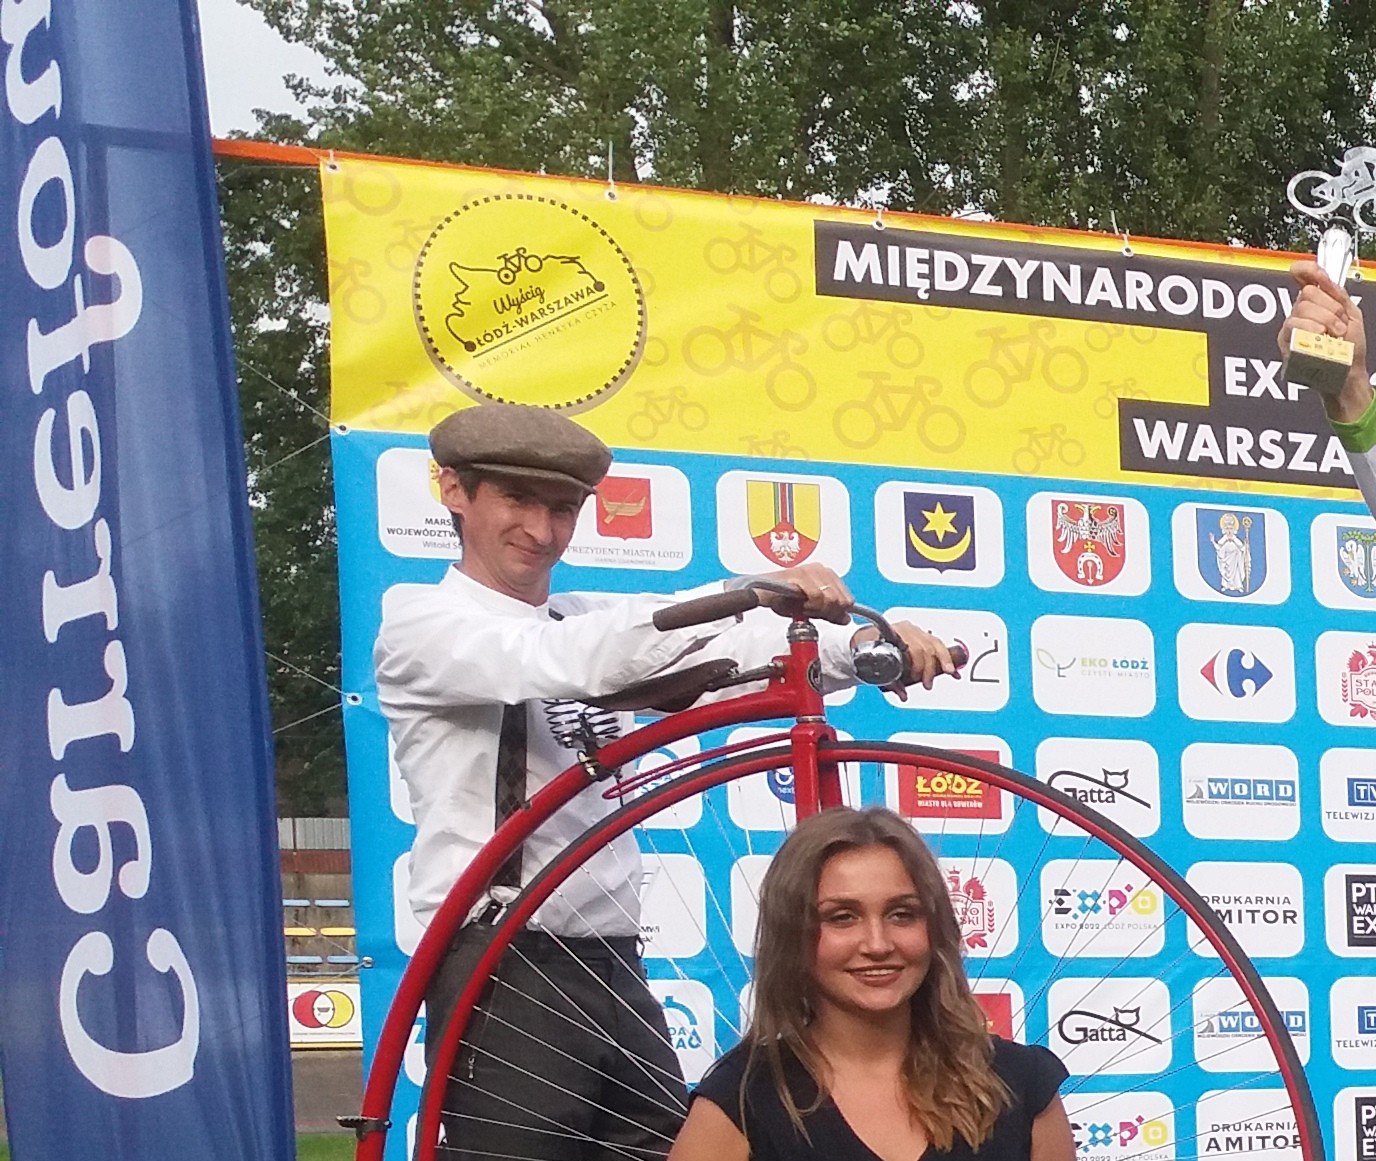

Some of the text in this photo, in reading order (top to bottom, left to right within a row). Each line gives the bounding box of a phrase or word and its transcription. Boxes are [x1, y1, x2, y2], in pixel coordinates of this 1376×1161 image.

[832, 239, 1363, 326] MIĘDZYNARODO
[493, 285, 545, 314] Wyścig
[1224, 356, 1309, 402] EX
[386, 527, 462, 538] WOJEWÓDZTW
[1081, 658, 1108, 668] EKO
[1207, 780, 1294, 798] WORD
[1215, 909, 1298, 925] MITOR
[1219, 1013, 1304, 1028] WOD
